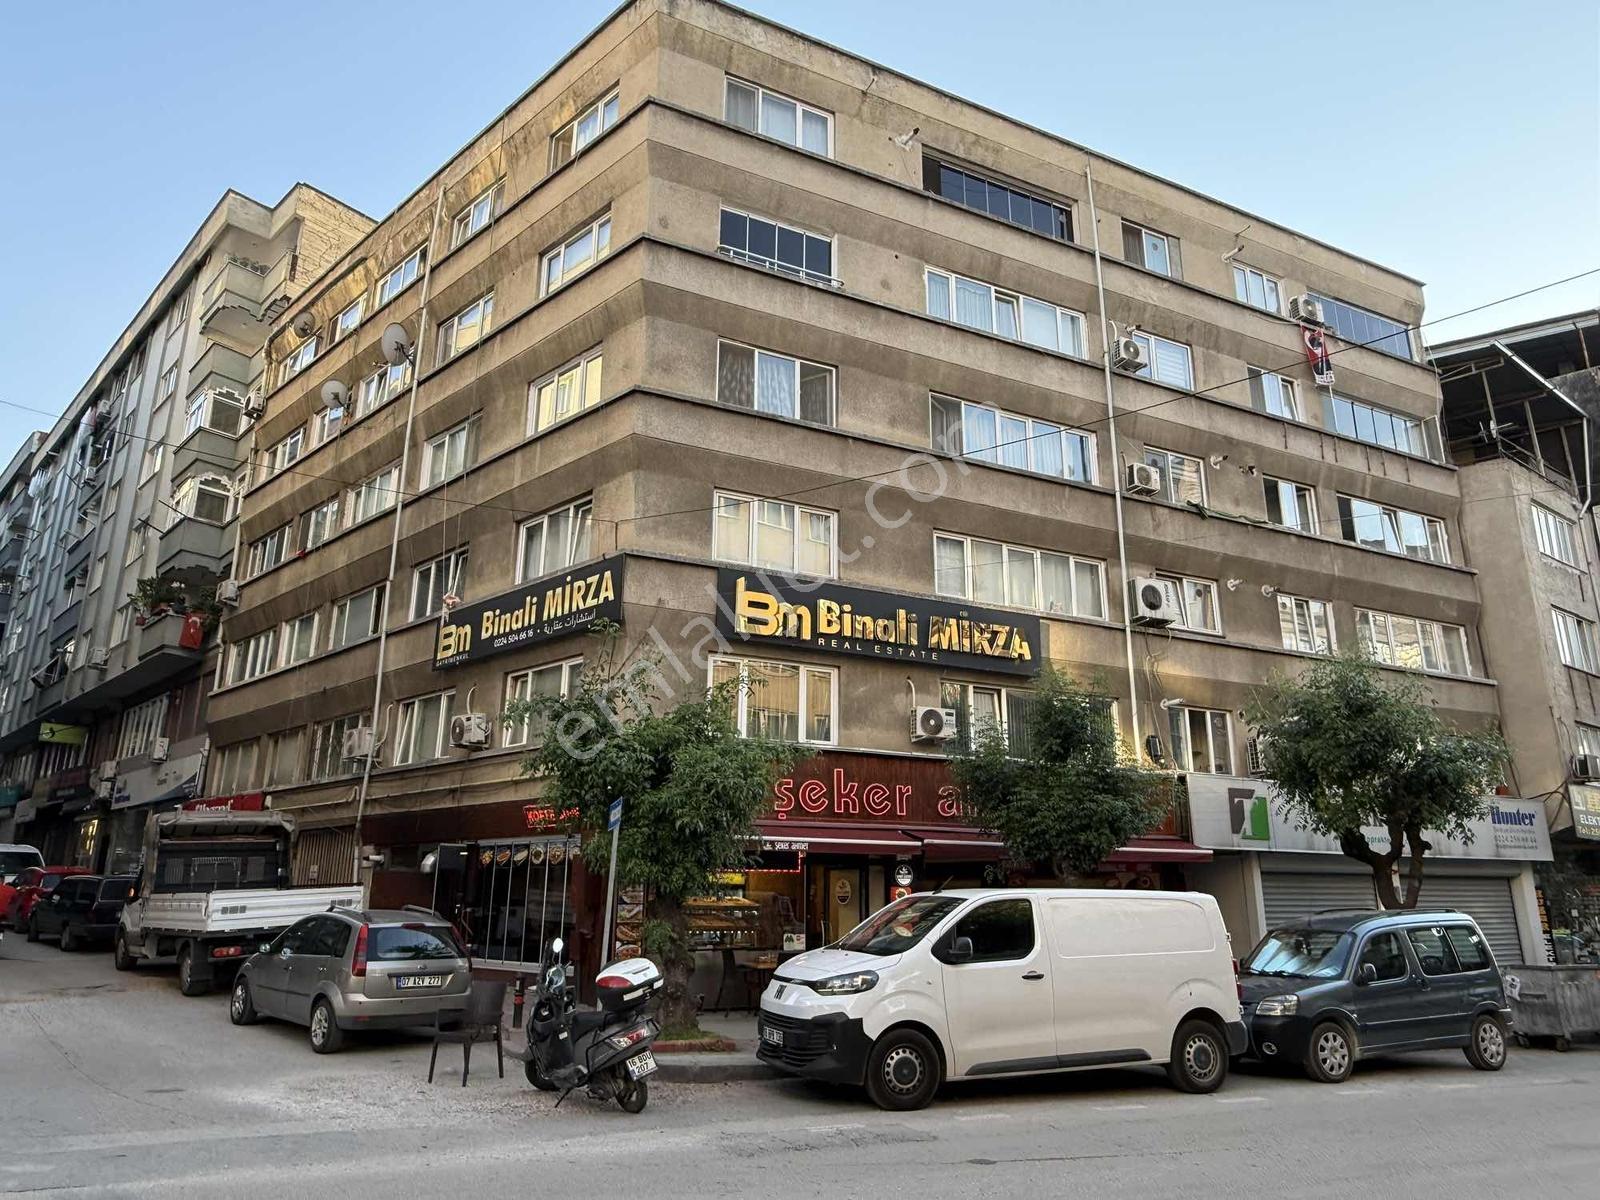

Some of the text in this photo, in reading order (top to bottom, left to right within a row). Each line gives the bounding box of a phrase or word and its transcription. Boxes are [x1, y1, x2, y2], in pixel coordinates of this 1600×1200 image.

[481, 570, 615, 640] Binali MİRZA
[817, 599, 1032, 661] Binali MİRZA
[818, 637, 938, 660] REAL ESTATE
[774, 768, 912, 820] şeker
[1490, 804, 1536, 826] Hunter
